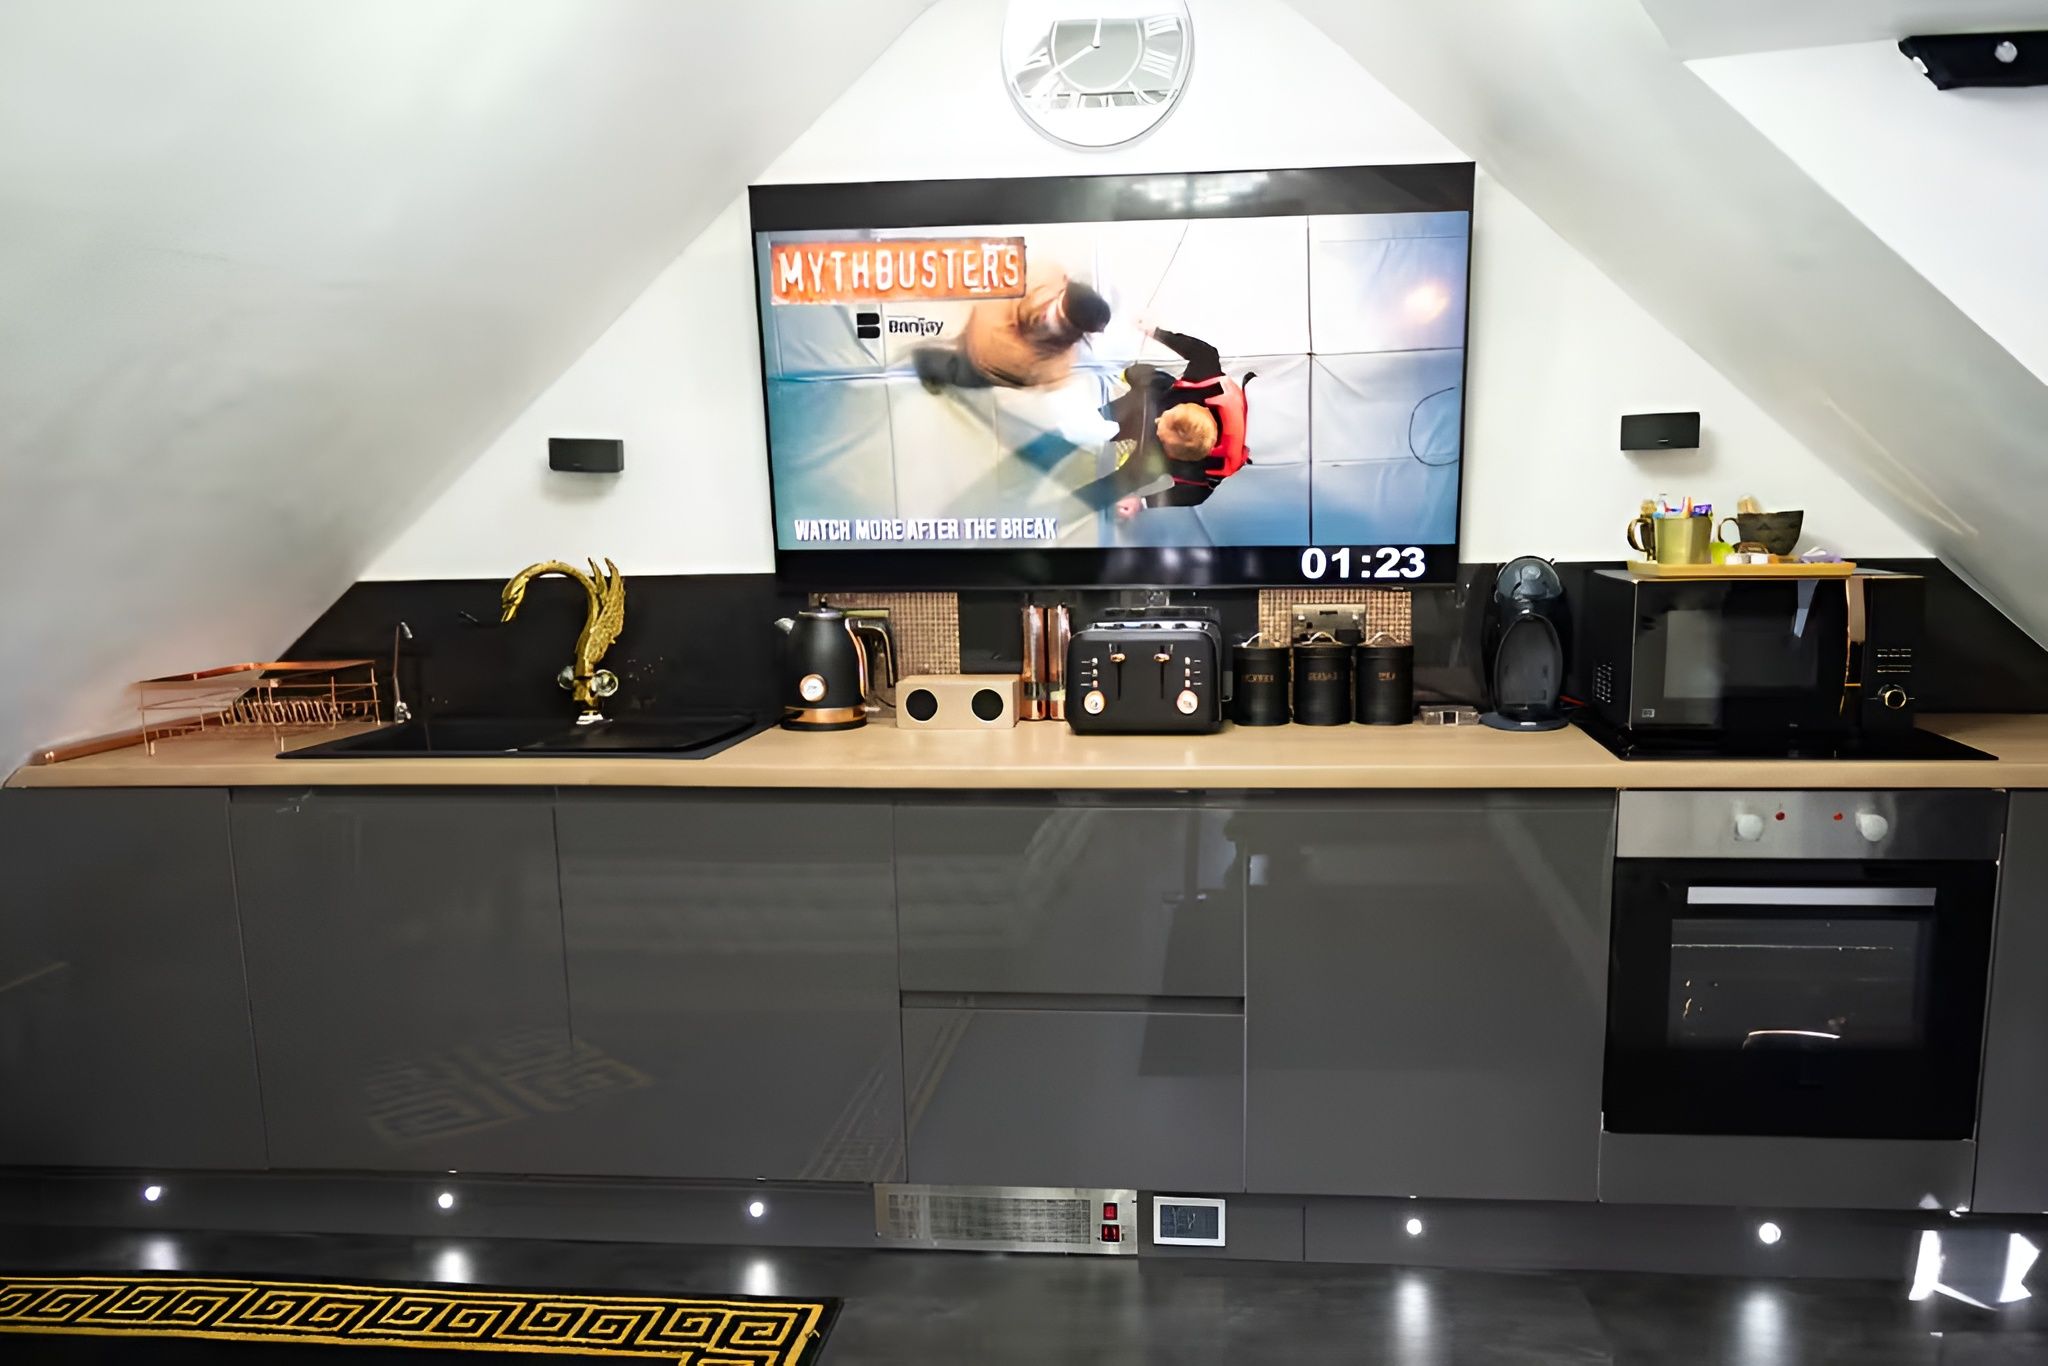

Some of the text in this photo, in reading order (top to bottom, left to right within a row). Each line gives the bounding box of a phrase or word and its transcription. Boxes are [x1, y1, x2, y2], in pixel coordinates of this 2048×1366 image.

[778, 246, 1021, 293] MYTHBUSTERS
[794, 517, 1057, 541] WATCH MORE AFTER THE BREAK
[1300, 546, 1426, 579] 01:23
